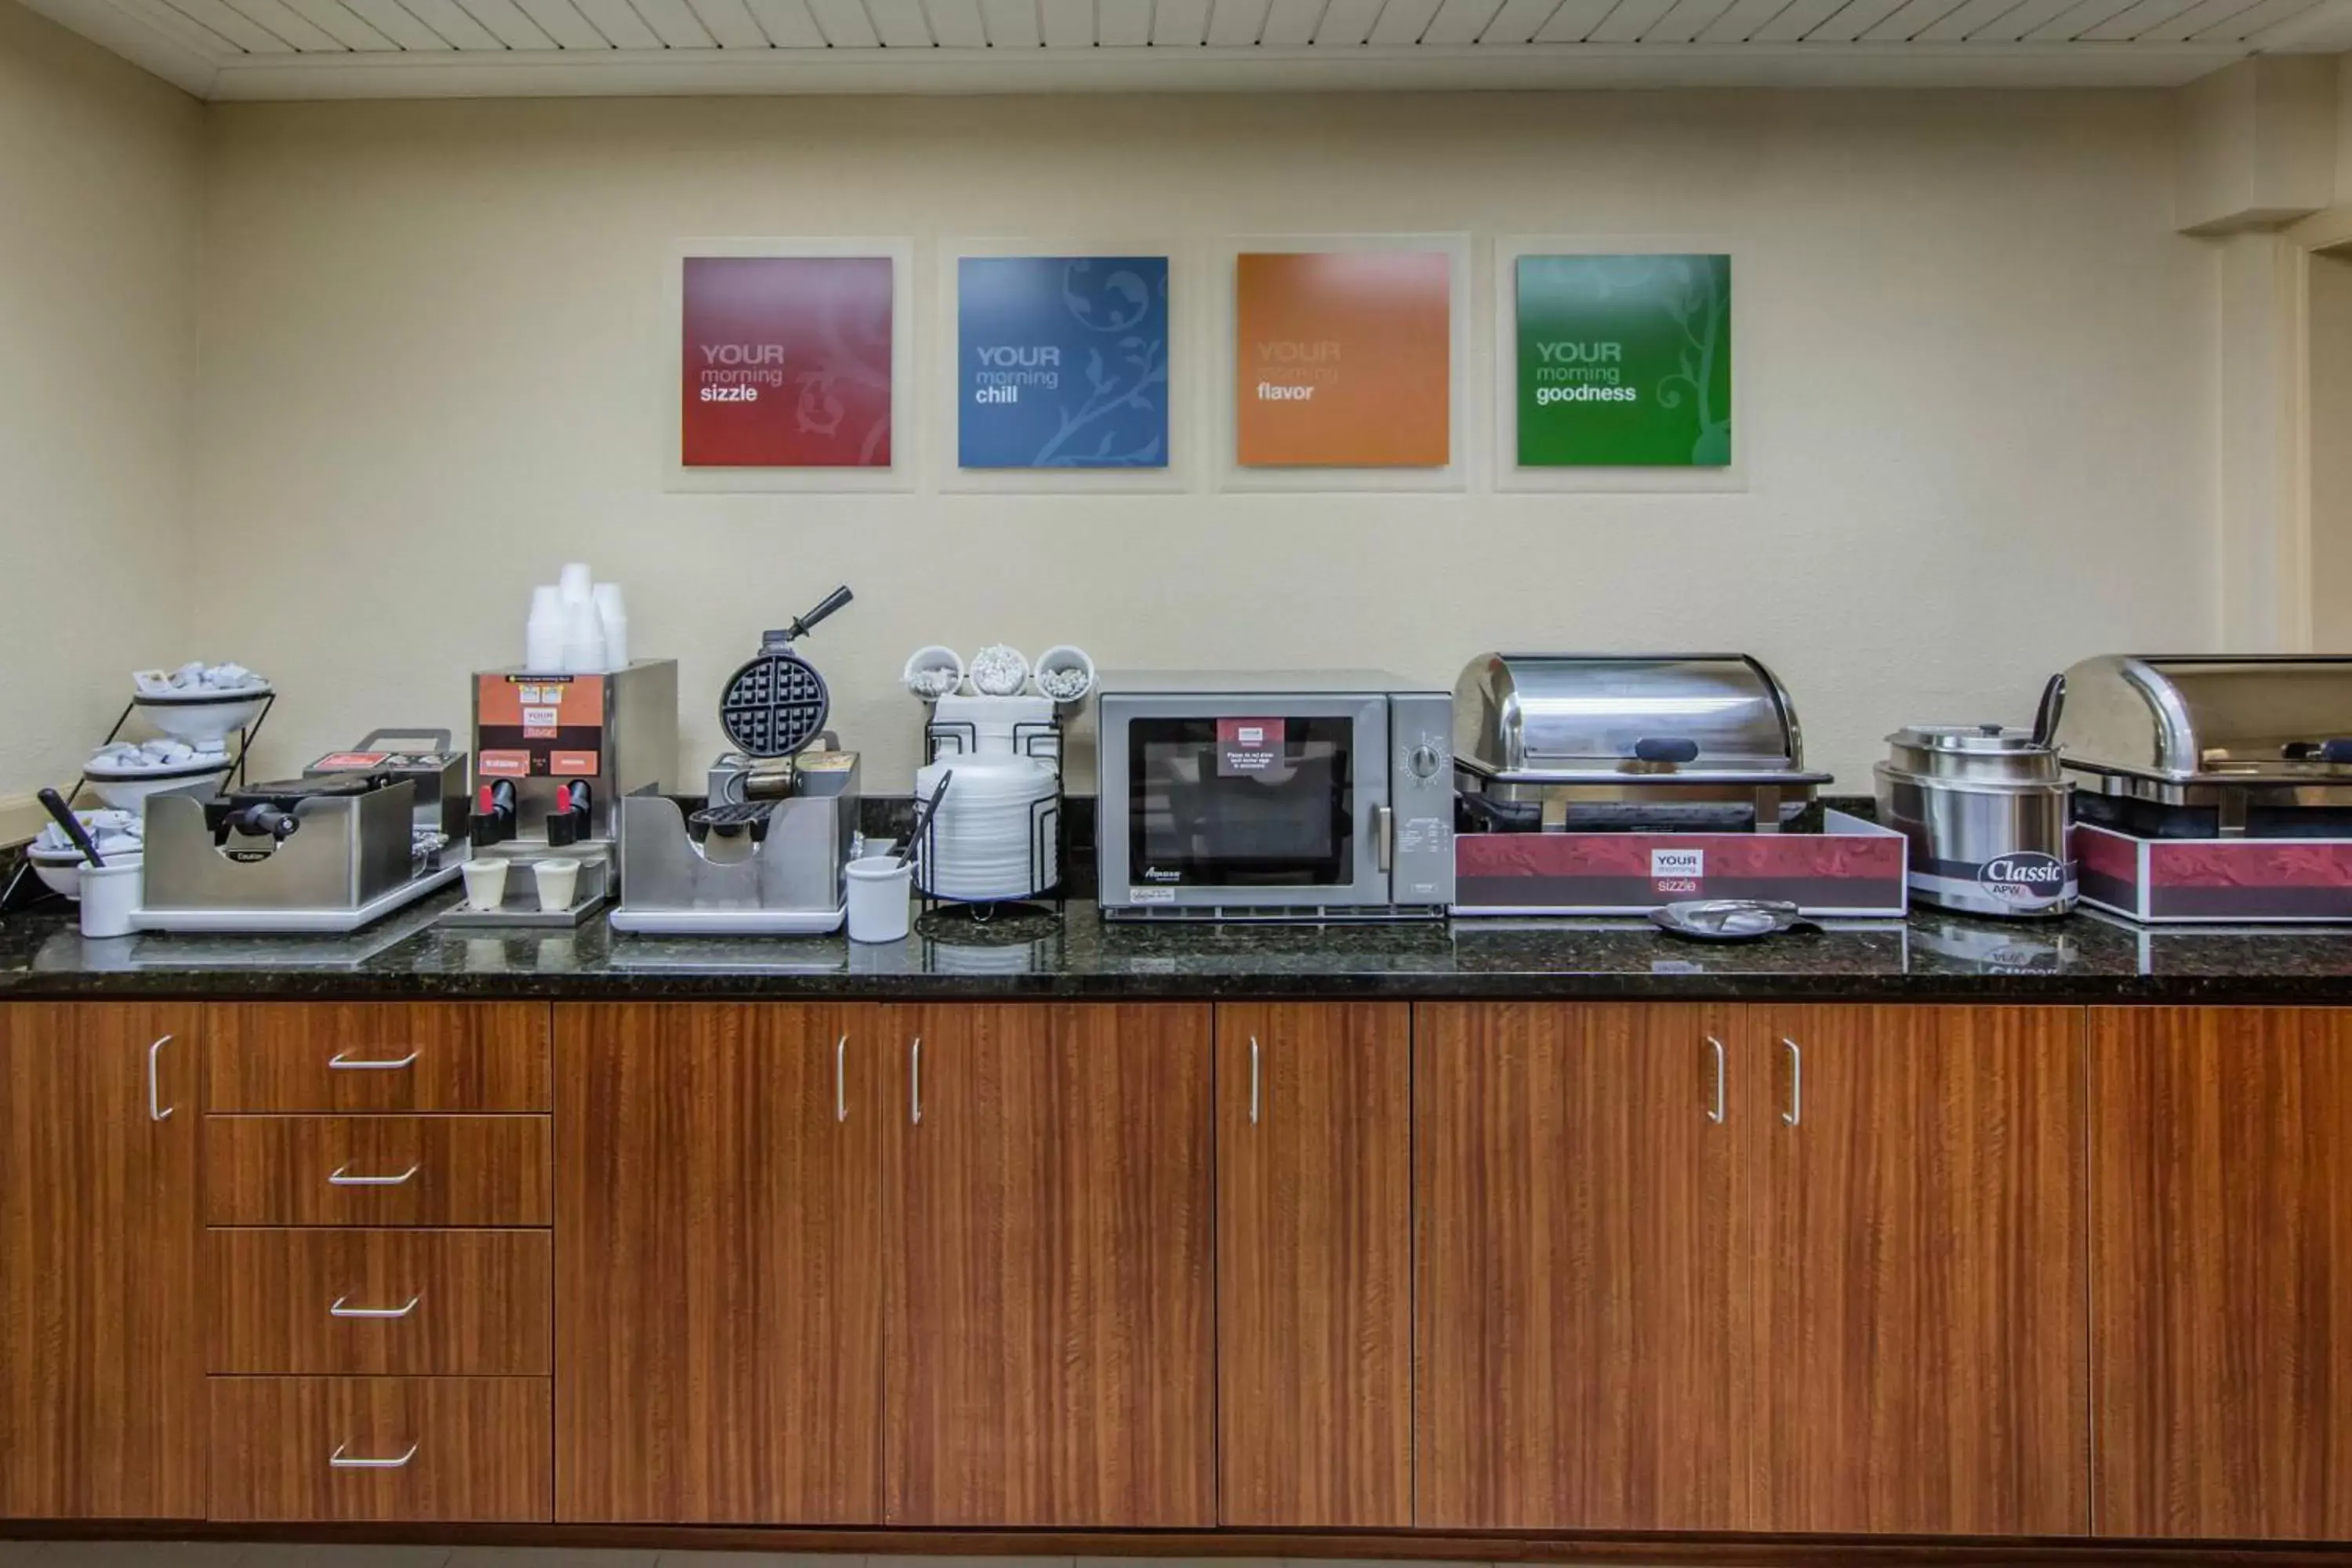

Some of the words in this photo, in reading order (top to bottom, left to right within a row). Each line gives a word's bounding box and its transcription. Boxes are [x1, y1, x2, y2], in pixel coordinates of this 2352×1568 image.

[700, 344, 784, 365] YOUR
[977, 346, 1060, 367] YOUR
[1257, 341, 1341, 362] YOUR
[1537, 342, 1621, 362] YOUR
[701, 366, 782, 387] morning
[976, 368, 1058, 390] morning
[1537, 364, 1620, 385] morning
[700, 383, 757, 401] sizzle
[976, 385, 1018, 404] chill
[1257, 382, 1315, 401] flavor
[1537, 383, 1636, 405] goodness
[1657, 855, 1697, 866] YOUR
[1987, 860, 2061, 882] Classic
[1657, 877, 1696, 891] sizzle
